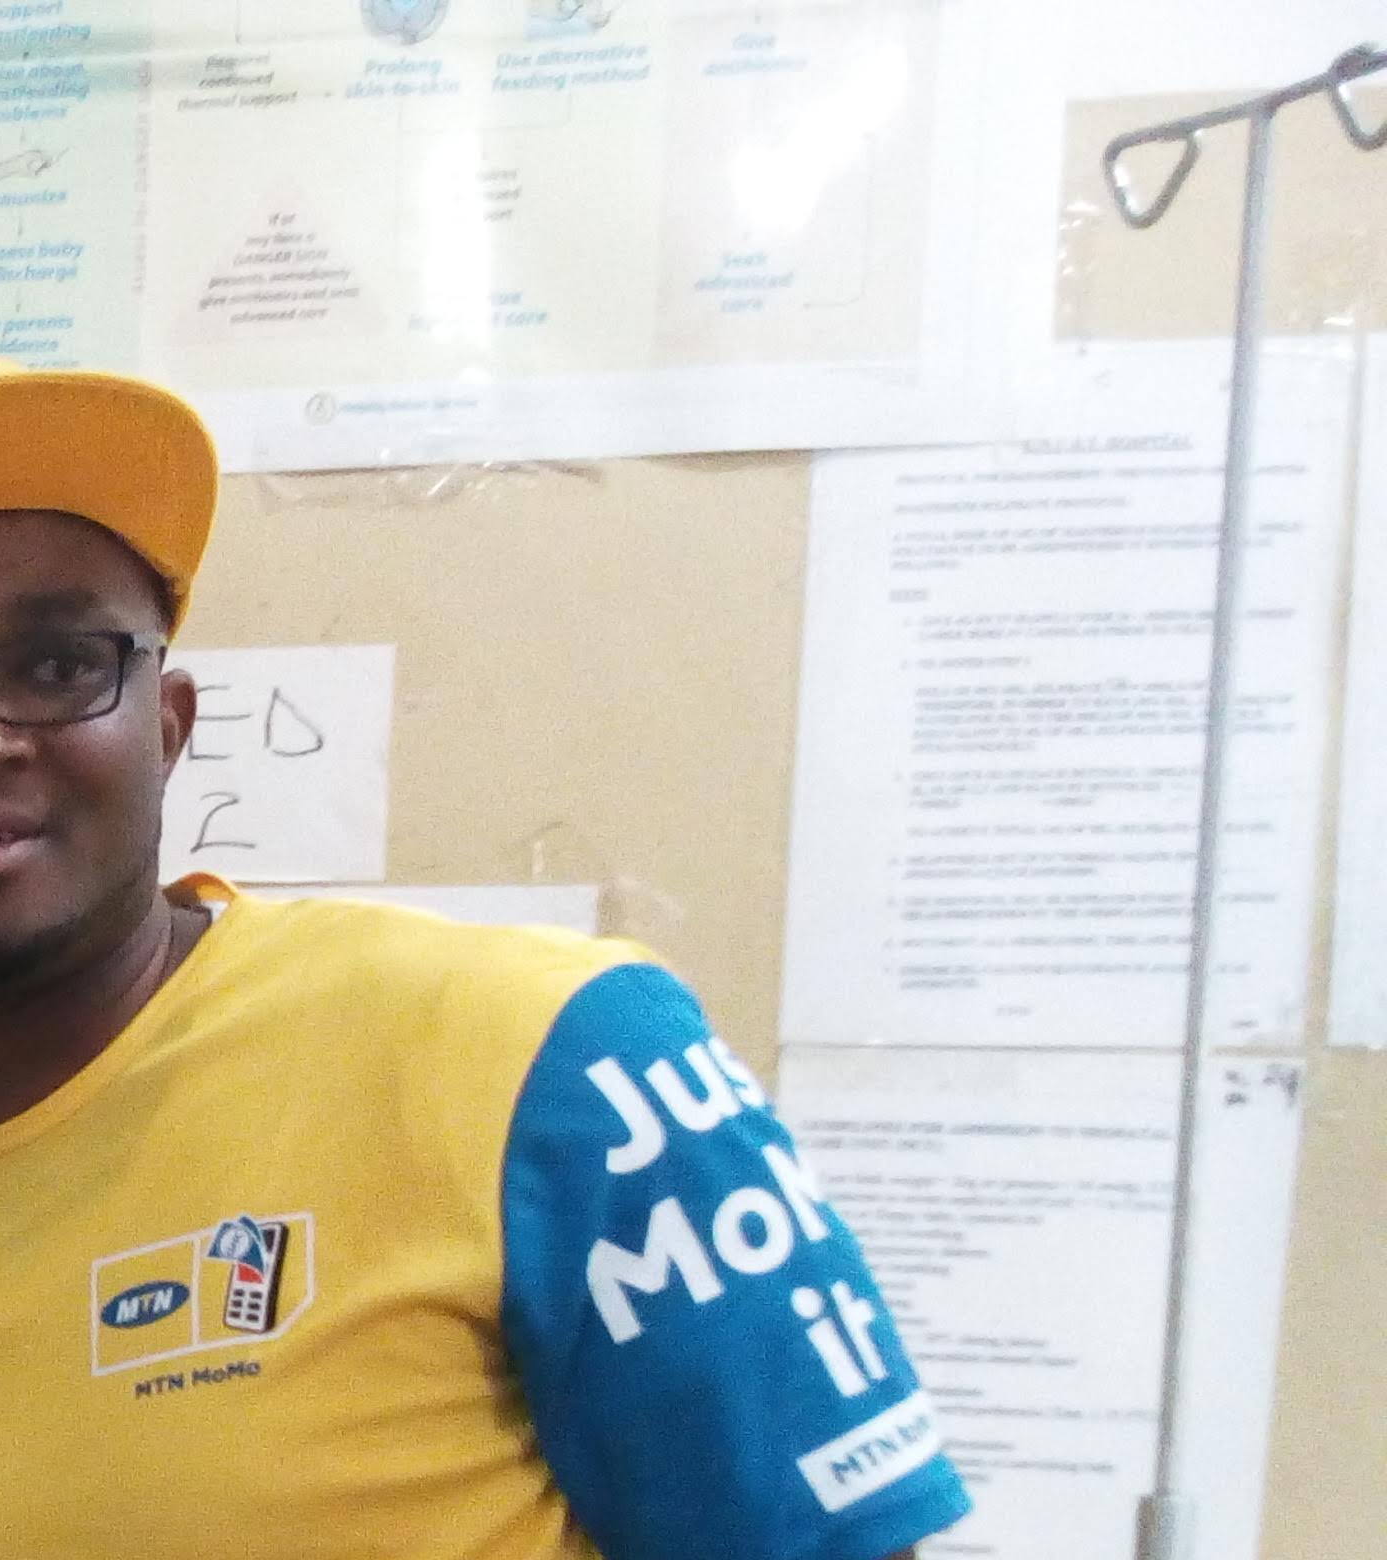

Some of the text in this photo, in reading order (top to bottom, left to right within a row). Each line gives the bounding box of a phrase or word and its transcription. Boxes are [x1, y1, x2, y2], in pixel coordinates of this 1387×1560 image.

[189, 790, 257, 855] 2
[114, 1286, 174, 1324] MTN
[791, 1280, 890, 1398] it
[135, 1373, 185, 1398] MTN
